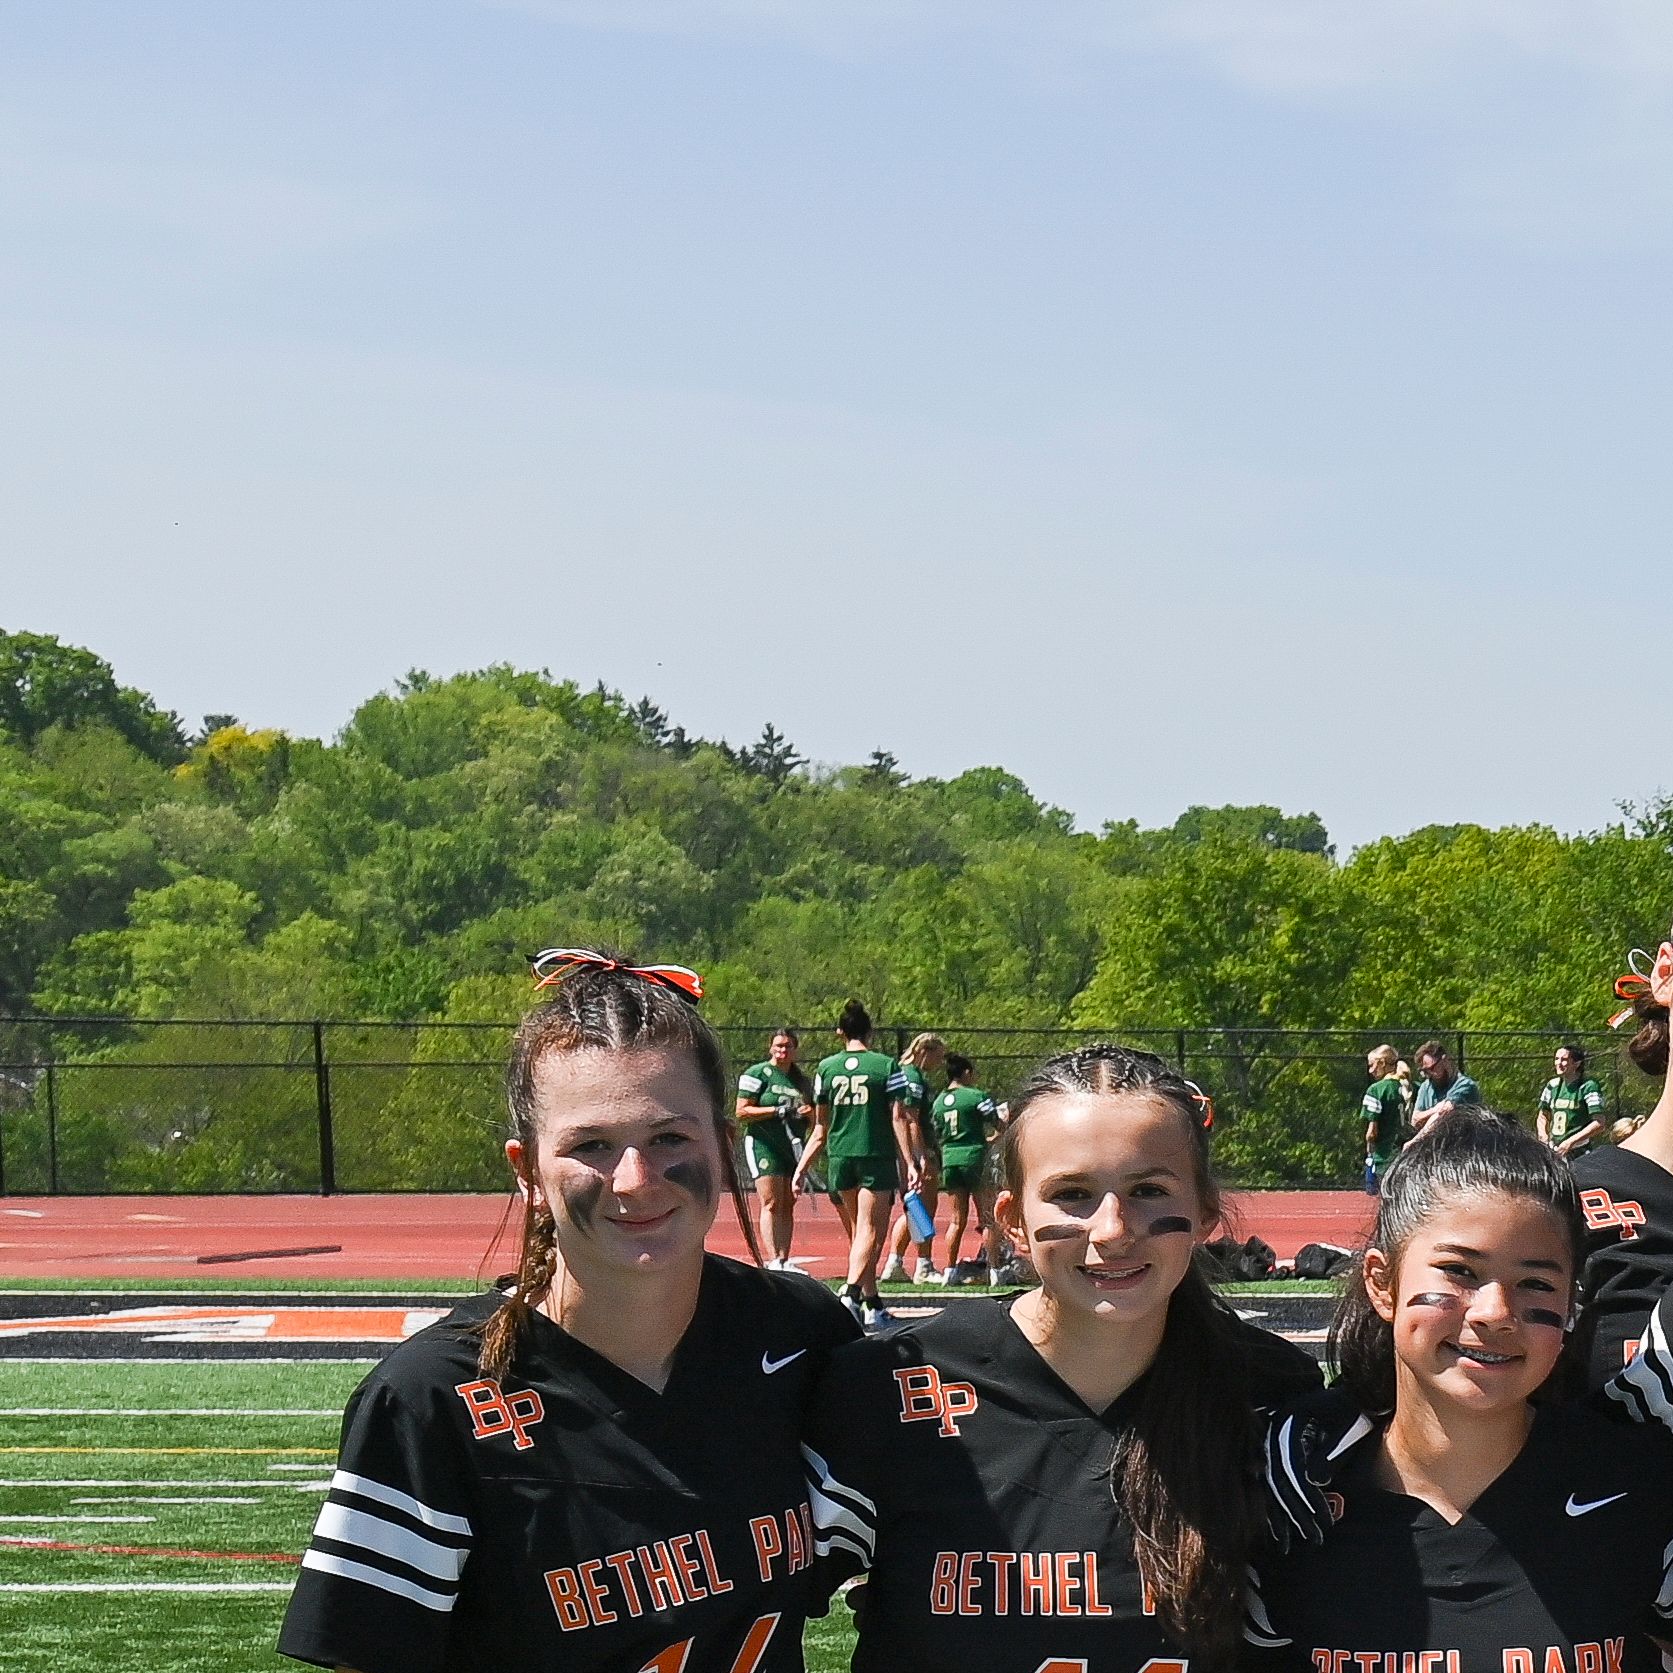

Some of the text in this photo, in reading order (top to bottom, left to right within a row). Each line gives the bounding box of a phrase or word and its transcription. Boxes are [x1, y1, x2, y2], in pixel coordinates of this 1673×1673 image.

[832, 1075, 868, 1106] 25
[1579, 1188, 1647, 1240] BP
[454, 1377, 545, 1450] BP
[893, 1365, 978, 1437] BP
[544, 1530, 733, 1631] BETHEL
[930, 1552, 1112, 1616] BETHEL
